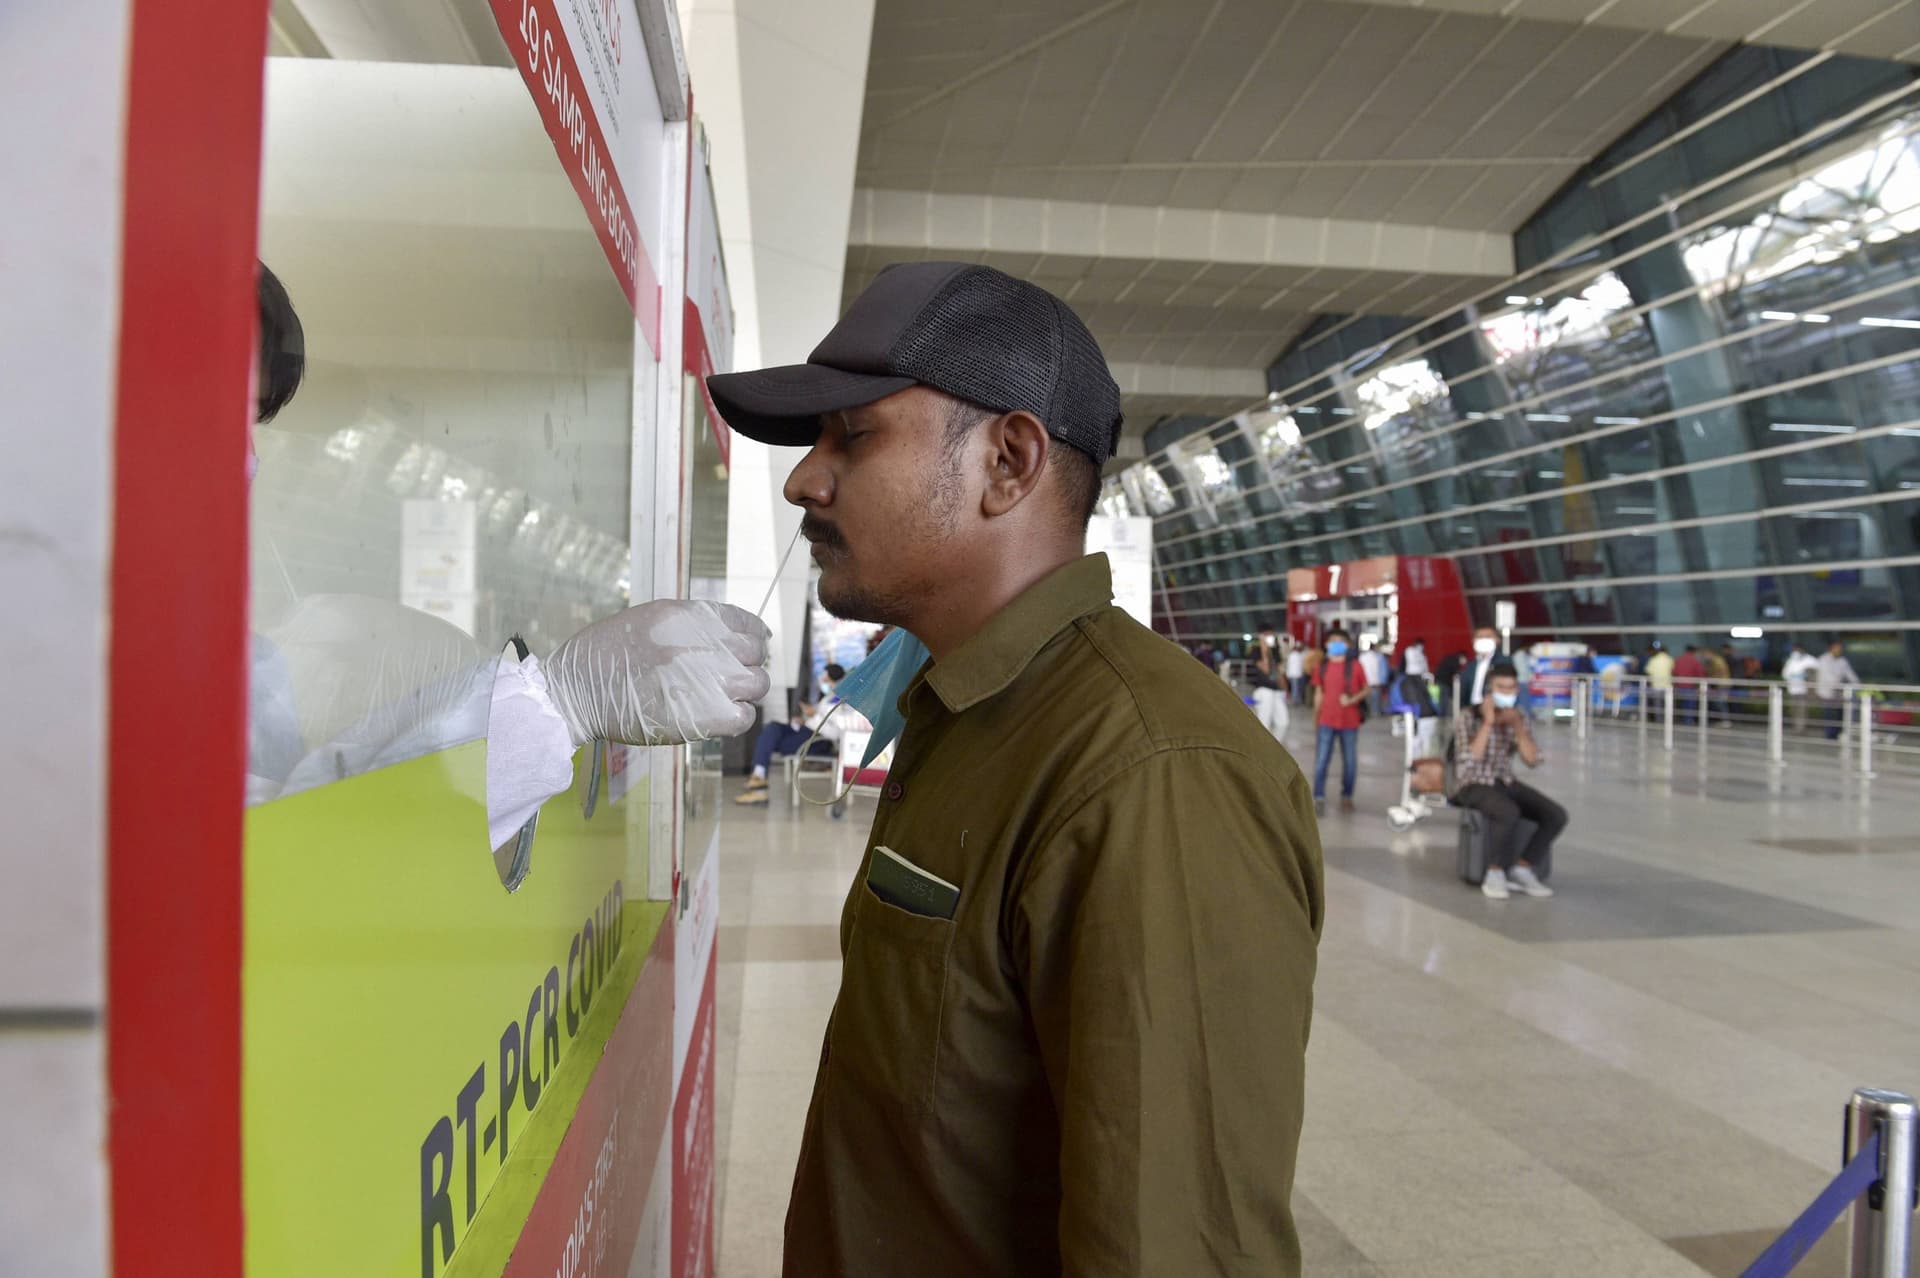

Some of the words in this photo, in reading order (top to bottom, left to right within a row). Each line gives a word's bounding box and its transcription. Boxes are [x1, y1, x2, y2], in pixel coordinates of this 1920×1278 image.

[542, 29, 607, 222] SAMPLING
[607, 187, 637, 287] BOOTH
[1327, 564, 1342, 595] 7
[421, 965, 560, 1278] RT-PCR
[565, 879, 623, 1039] COVID
